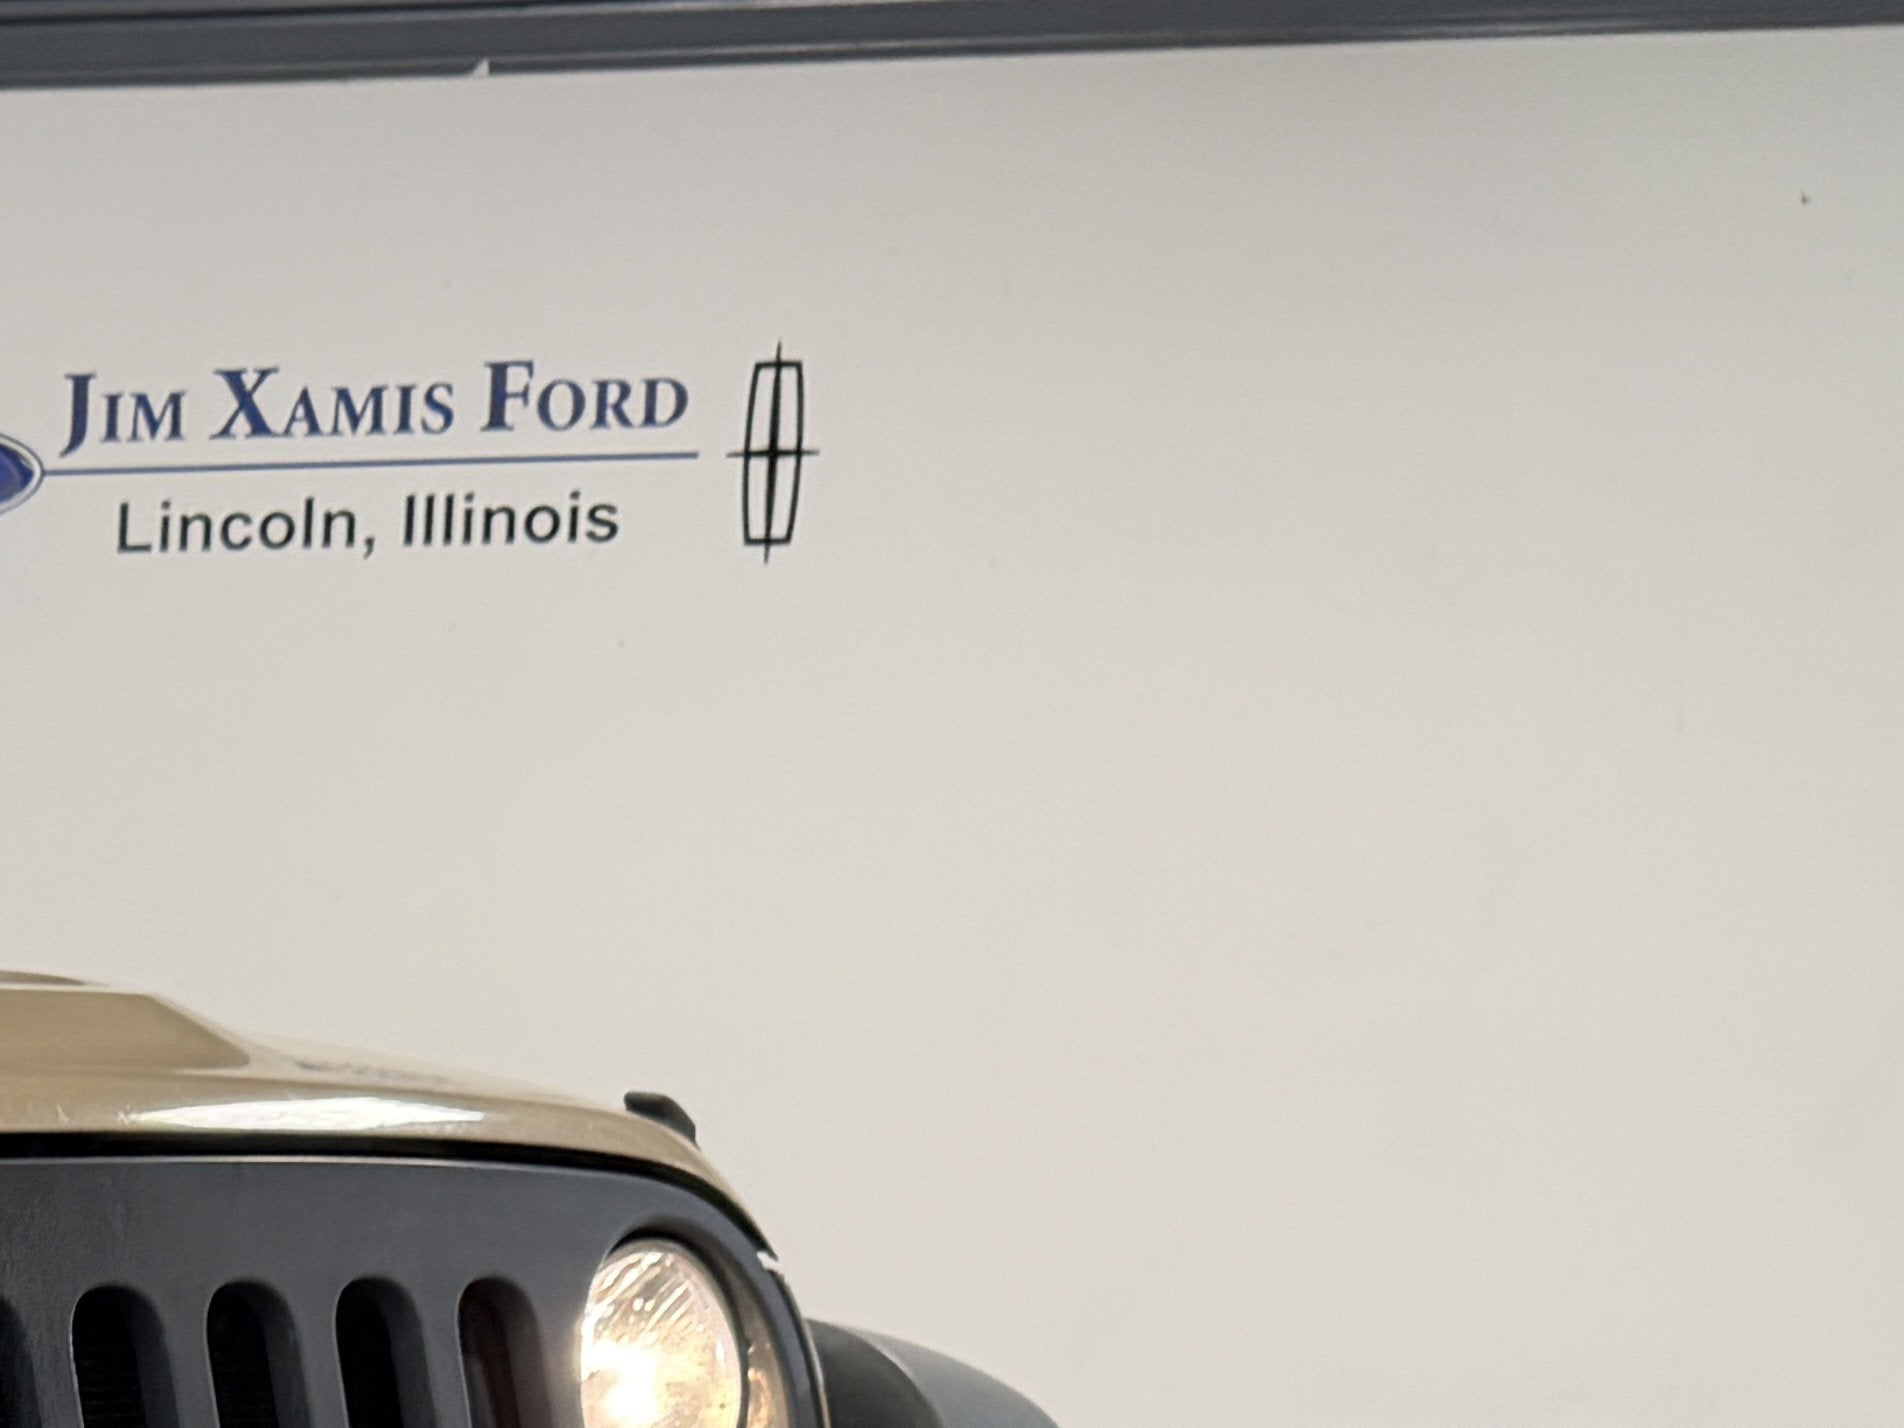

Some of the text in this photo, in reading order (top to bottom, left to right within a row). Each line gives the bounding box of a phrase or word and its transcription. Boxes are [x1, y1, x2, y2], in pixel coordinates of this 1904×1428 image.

[60, 360, 690, 457] JIM XAMIS FORD
[117, 490, 620, 558] Lincoln, Illinois
